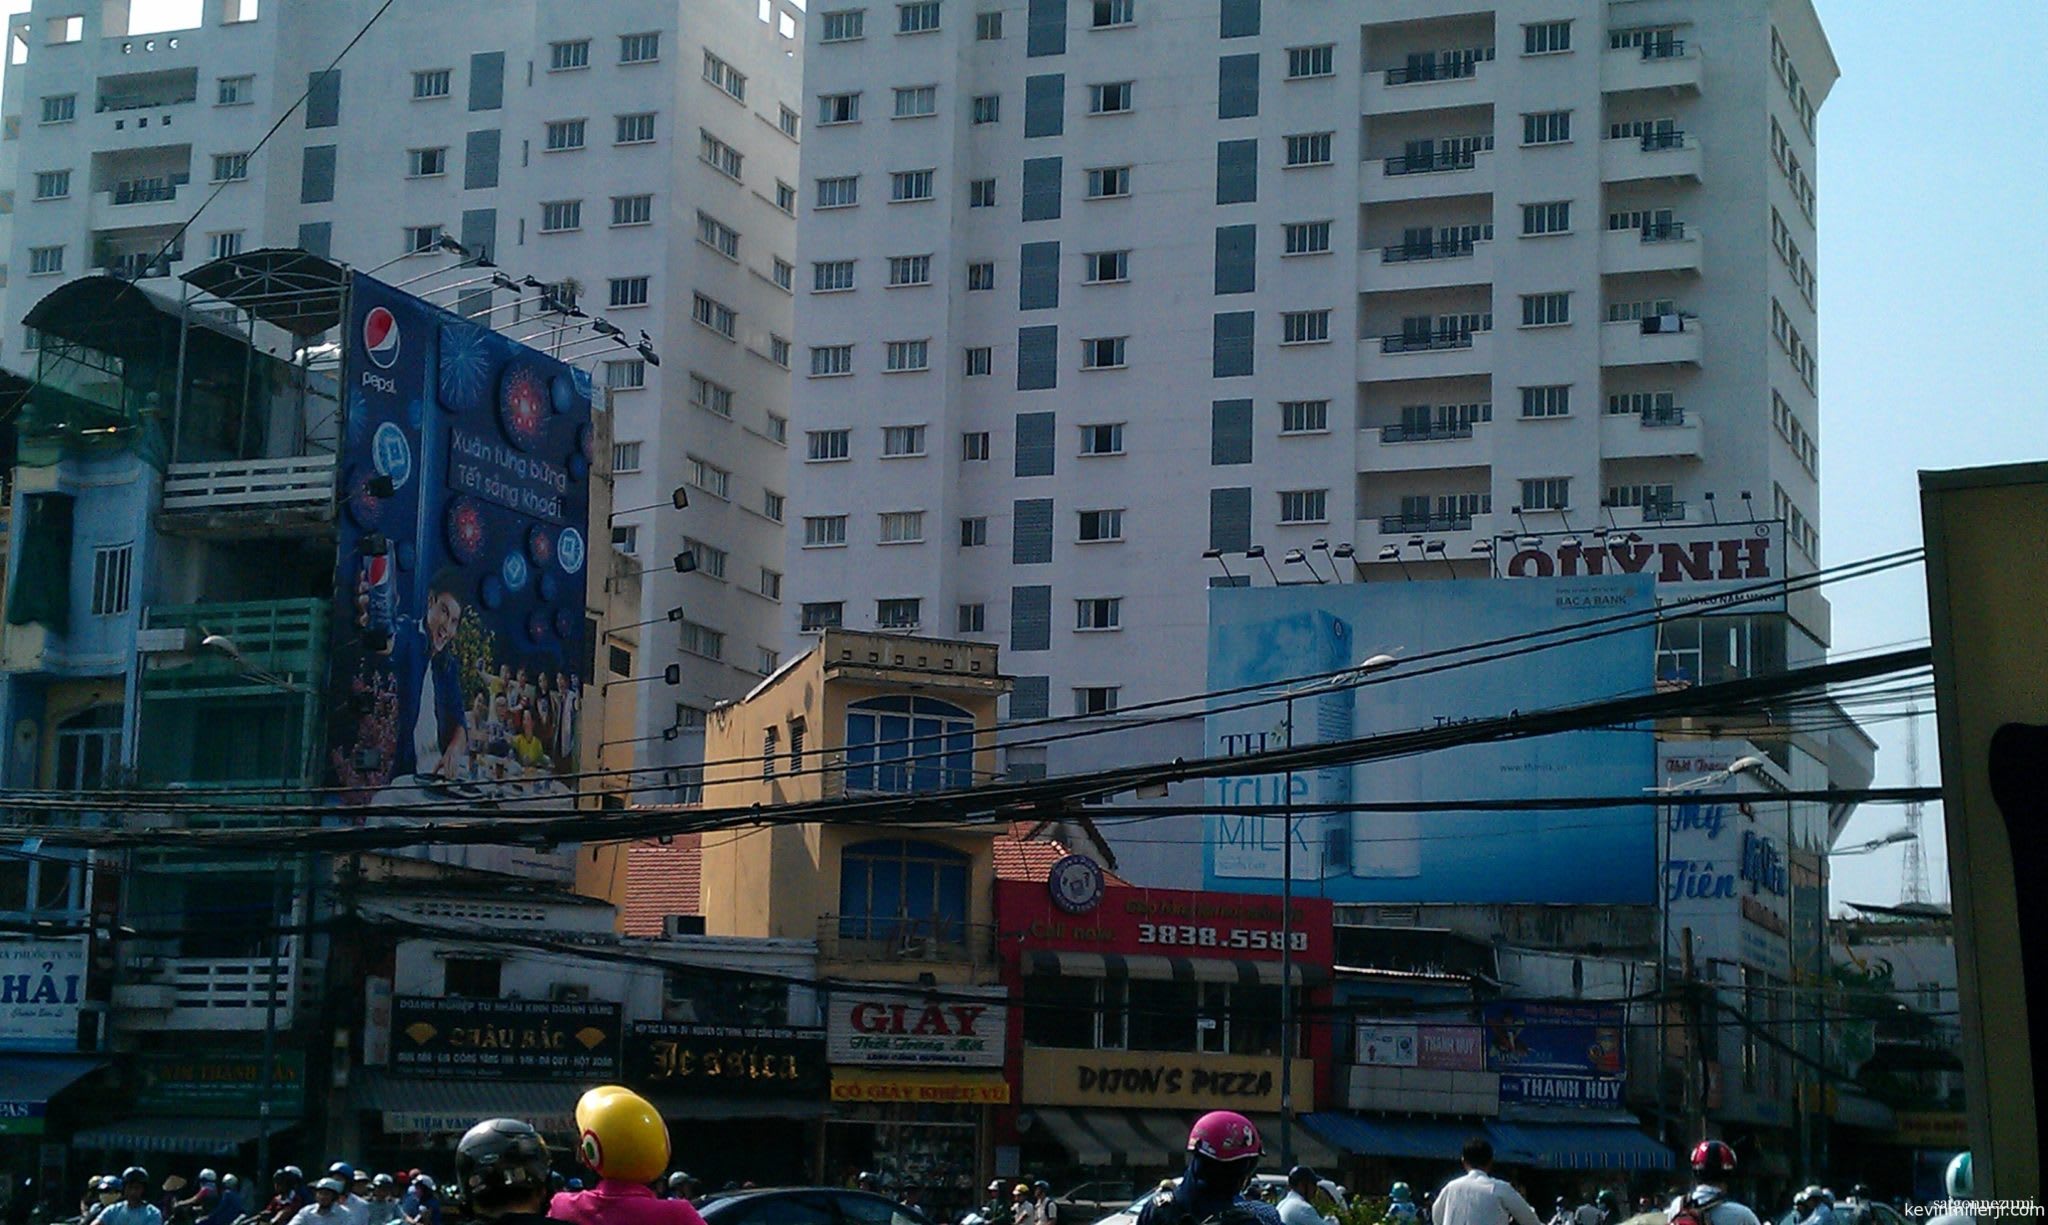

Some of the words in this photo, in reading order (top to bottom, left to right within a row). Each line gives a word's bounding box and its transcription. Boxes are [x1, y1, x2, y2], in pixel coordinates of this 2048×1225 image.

[362, 371, 397, 394] pepsi
[458, 463, 481, 491] Tết
[1594, 595, 1627, 606] BANK
[1220, 731, 1270, 757] TH
[1218, 775, 1308, 806] true
[1219, 814, 1308, 852] MILK
[1138, 923, 1308, 951] 3838.5588
[1078, 1065, 1183, 1094] DIJON'S
[1190, 1067, 1273, 1097] PIZZA
[1520, 1078, 1580, 1099] THANH
[1585, 1080, 1621, 1100] HUY
